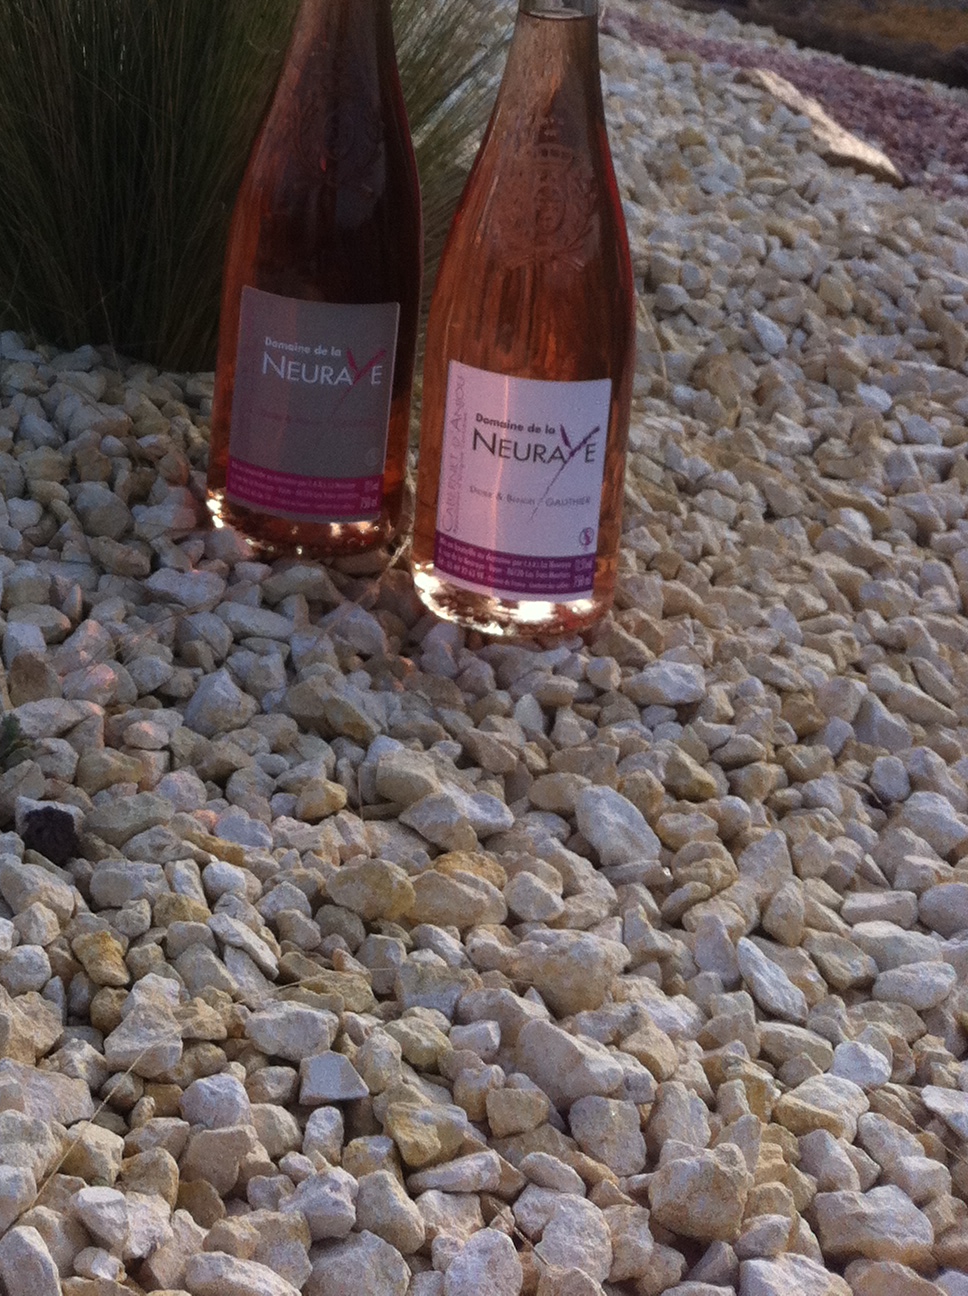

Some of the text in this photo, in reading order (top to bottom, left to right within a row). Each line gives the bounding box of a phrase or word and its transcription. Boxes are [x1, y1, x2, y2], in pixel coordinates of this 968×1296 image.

[264, 336, 342, 357] Domaine de la
[262, 348, 387, 392] NEURAYE
[475, 412, 556, 435] Domaine de la
[472, 423, 600, 479] NEURAYE
